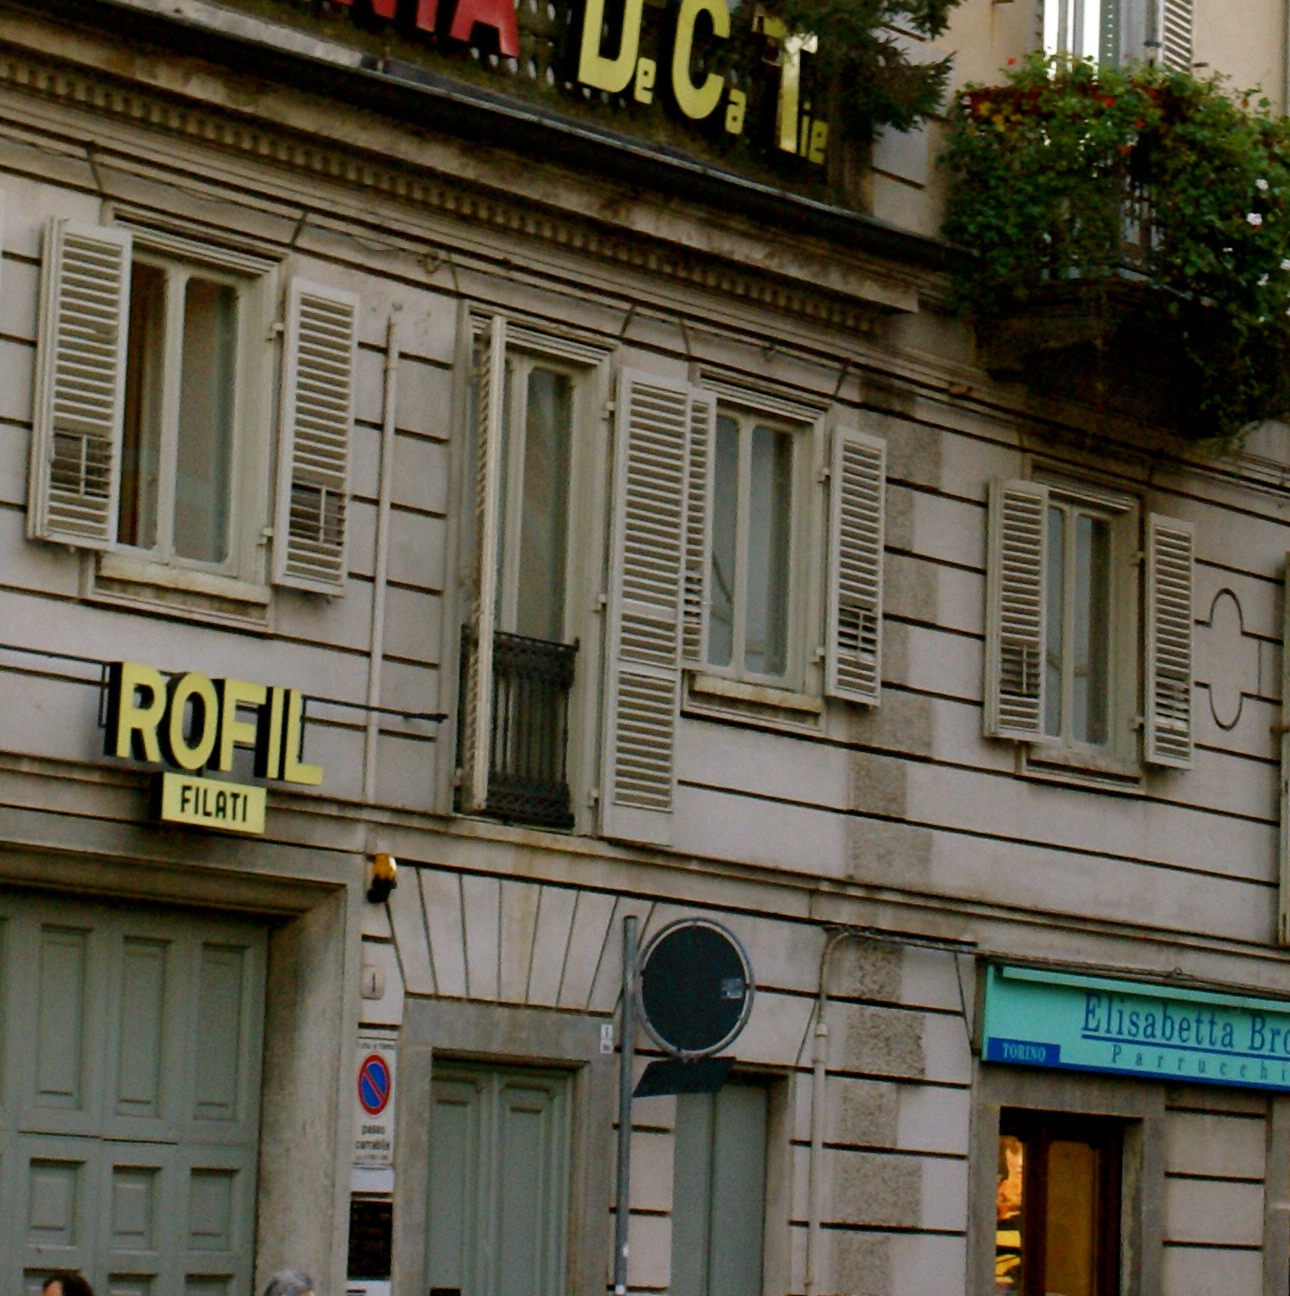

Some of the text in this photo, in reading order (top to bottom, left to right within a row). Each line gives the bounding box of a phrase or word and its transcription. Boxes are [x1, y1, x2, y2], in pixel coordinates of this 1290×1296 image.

[111, 660, 323, 786] ROFIL
[180, 784, 248, 823] FILATI
[1081, 992, 1235, 1049] Elisabetta
[1002, 1043, 1047, 1062] TORINO
